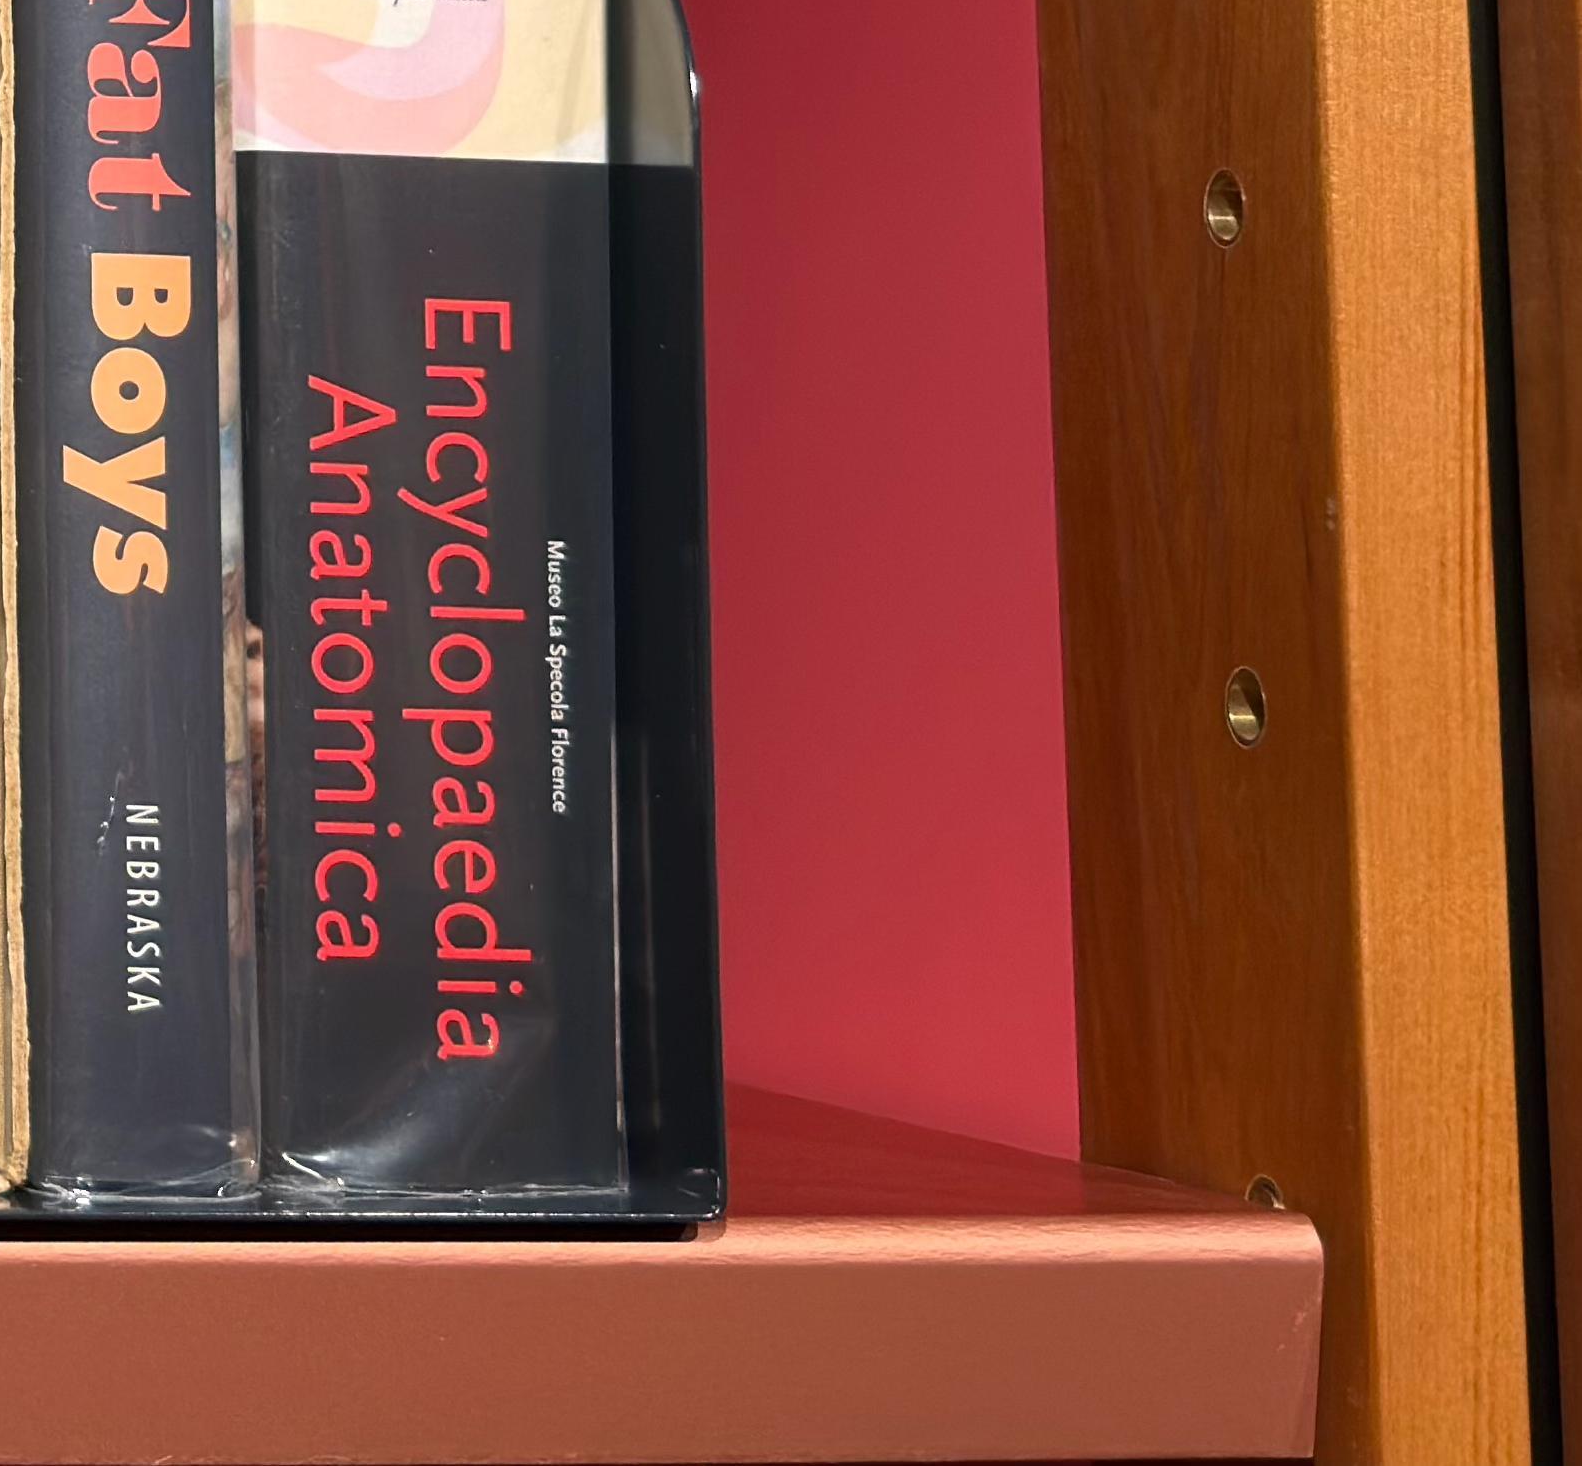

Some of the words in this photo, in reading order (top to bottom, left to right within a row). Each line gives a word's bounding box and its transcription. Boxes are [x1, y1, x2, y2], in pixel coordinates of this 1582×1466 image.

[62, 253, 192, 597] Boys
[307, 374, 406, 963] Anatomica
[398, 297, 532, 1061] Encyclopaedia
[546, 540, 566, 609] Museo
[547, 643, 572, 725] Specola
[550, 728, 570, 814] Florence
[125, 804, 161, 1014] NEBRASKA
